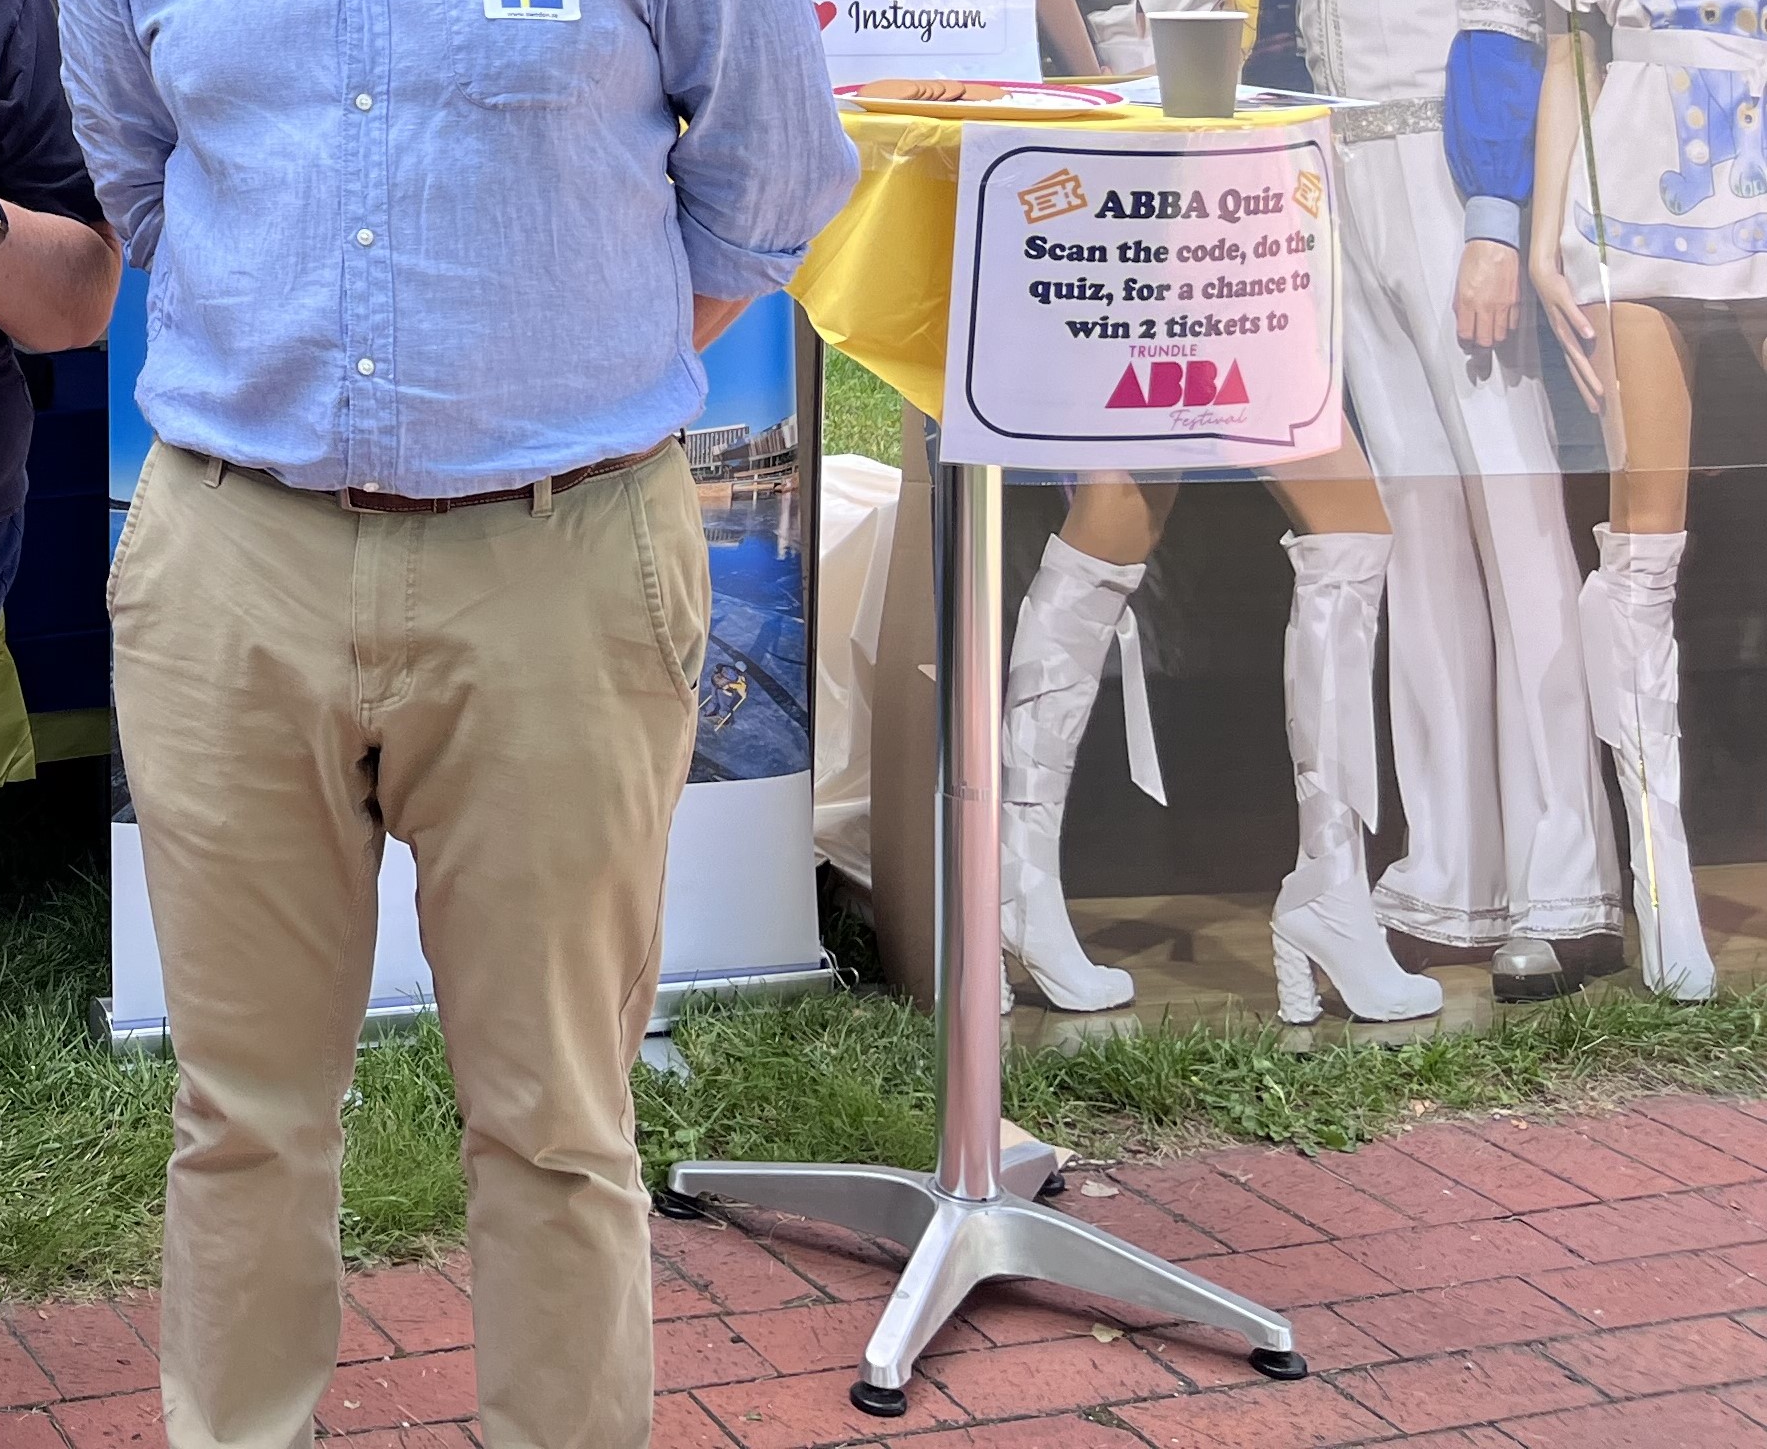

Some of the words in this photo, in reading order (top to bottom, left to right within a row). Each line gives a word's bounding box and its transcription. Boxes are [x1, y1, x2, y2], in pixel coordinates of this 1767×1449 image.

[848, 0, 986, 43] Instagram
[1095, 190, 1209, 219] ABBA
[1217, 186, 1283, 223] Quiz
[1024, 235, 1108, 263] Scan
[1116, 241, 1168, 263] the
[1176, 238, 1247, 265] code,
[1253, 234, 1281, 258] do
[1286, 230, 1315, 253] the
[1029, 276, 1115, 306] quiz,
[1123, 276, 1170, 302] for
[1177, 283, 1195, 301] a
[1201, 275, 1287, 301] chance
[1291, 269, 1311, 291] to
[1065, 316, 1130, 339] win
[1138, 319, 1157, 339] 2
[1164, 312, 1261, 338] tickets
[1266, 309, 1289, 332] to
[1129, 343, 1198, 359] TRUNDLE
[1104, 358, 1250, 409] ABBA
[1170, 409, 1248, 431] Festival
